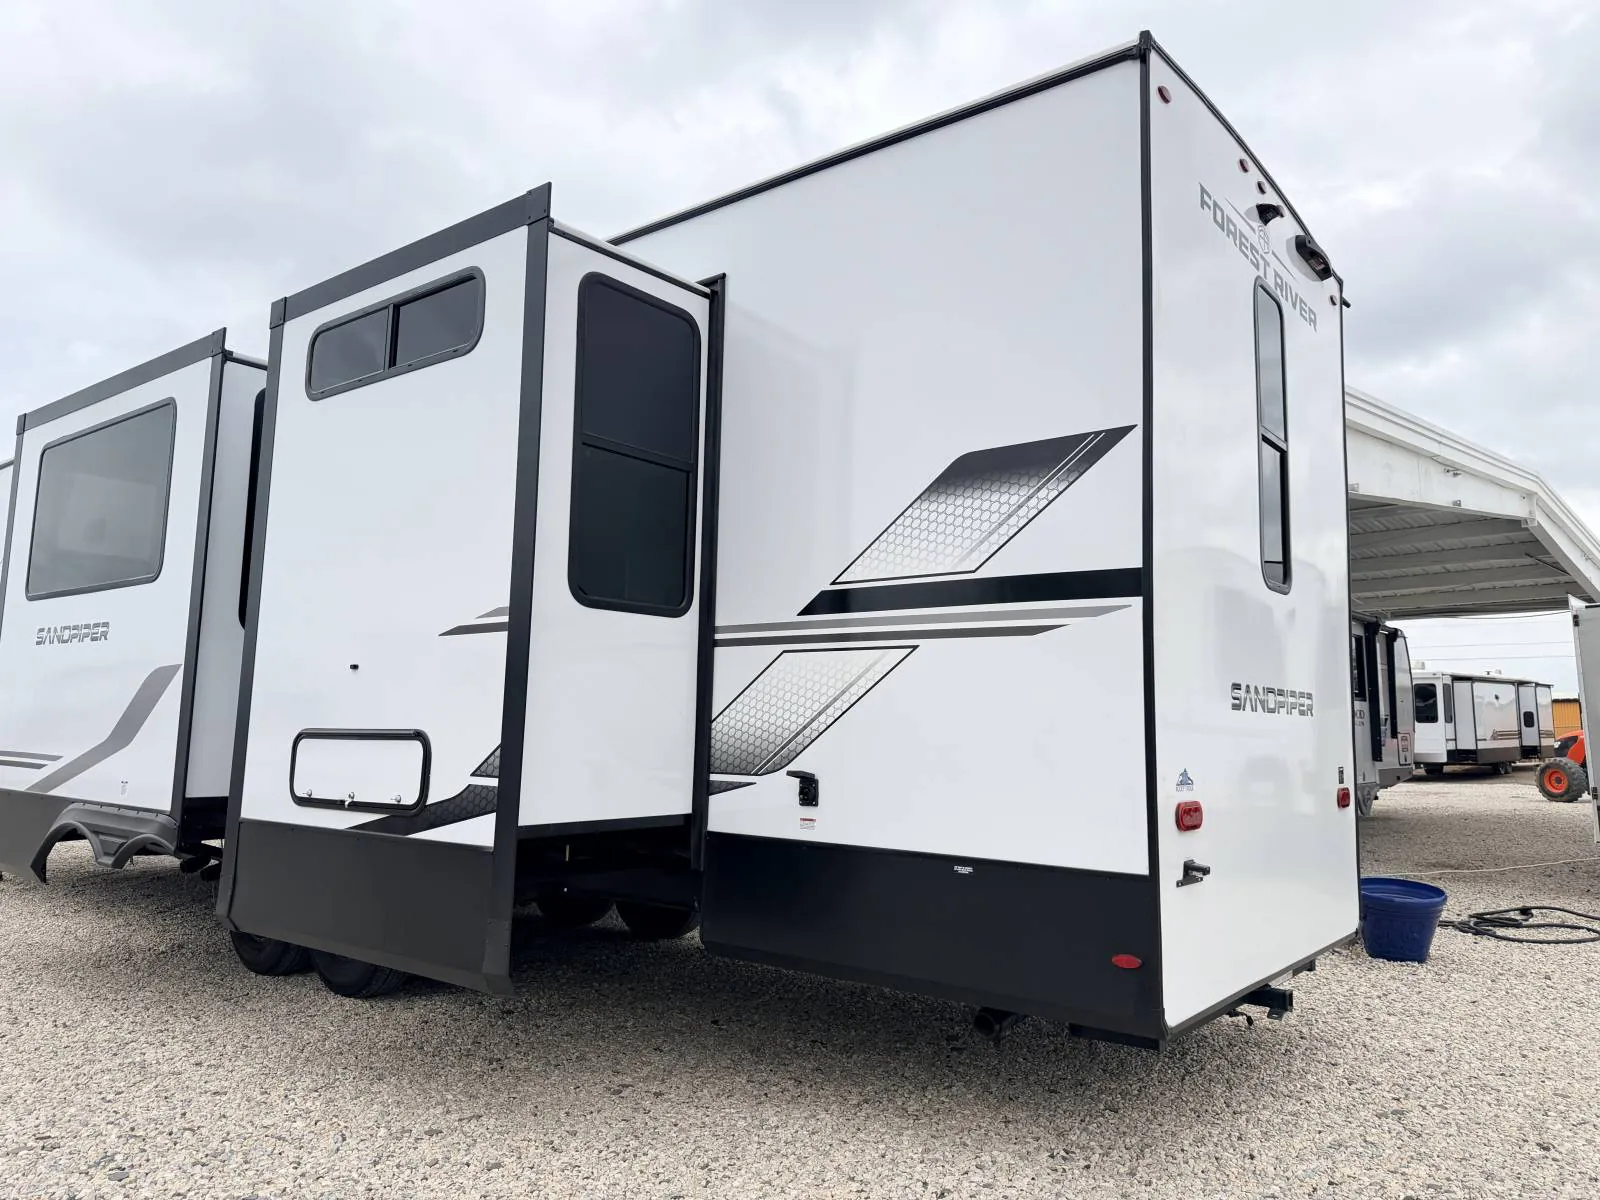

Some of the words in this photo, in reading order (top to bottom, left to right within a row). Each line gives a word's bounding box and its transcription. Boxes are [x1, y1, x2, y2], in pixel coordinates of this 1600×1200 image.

[1199, 182, 1271, 280] FOREST
[1273, 267, 1317, 333] RIVER
[36, 621, 109, 646] SANDPIPER
[1231, 682, 1314, 717] SANDPIPER
